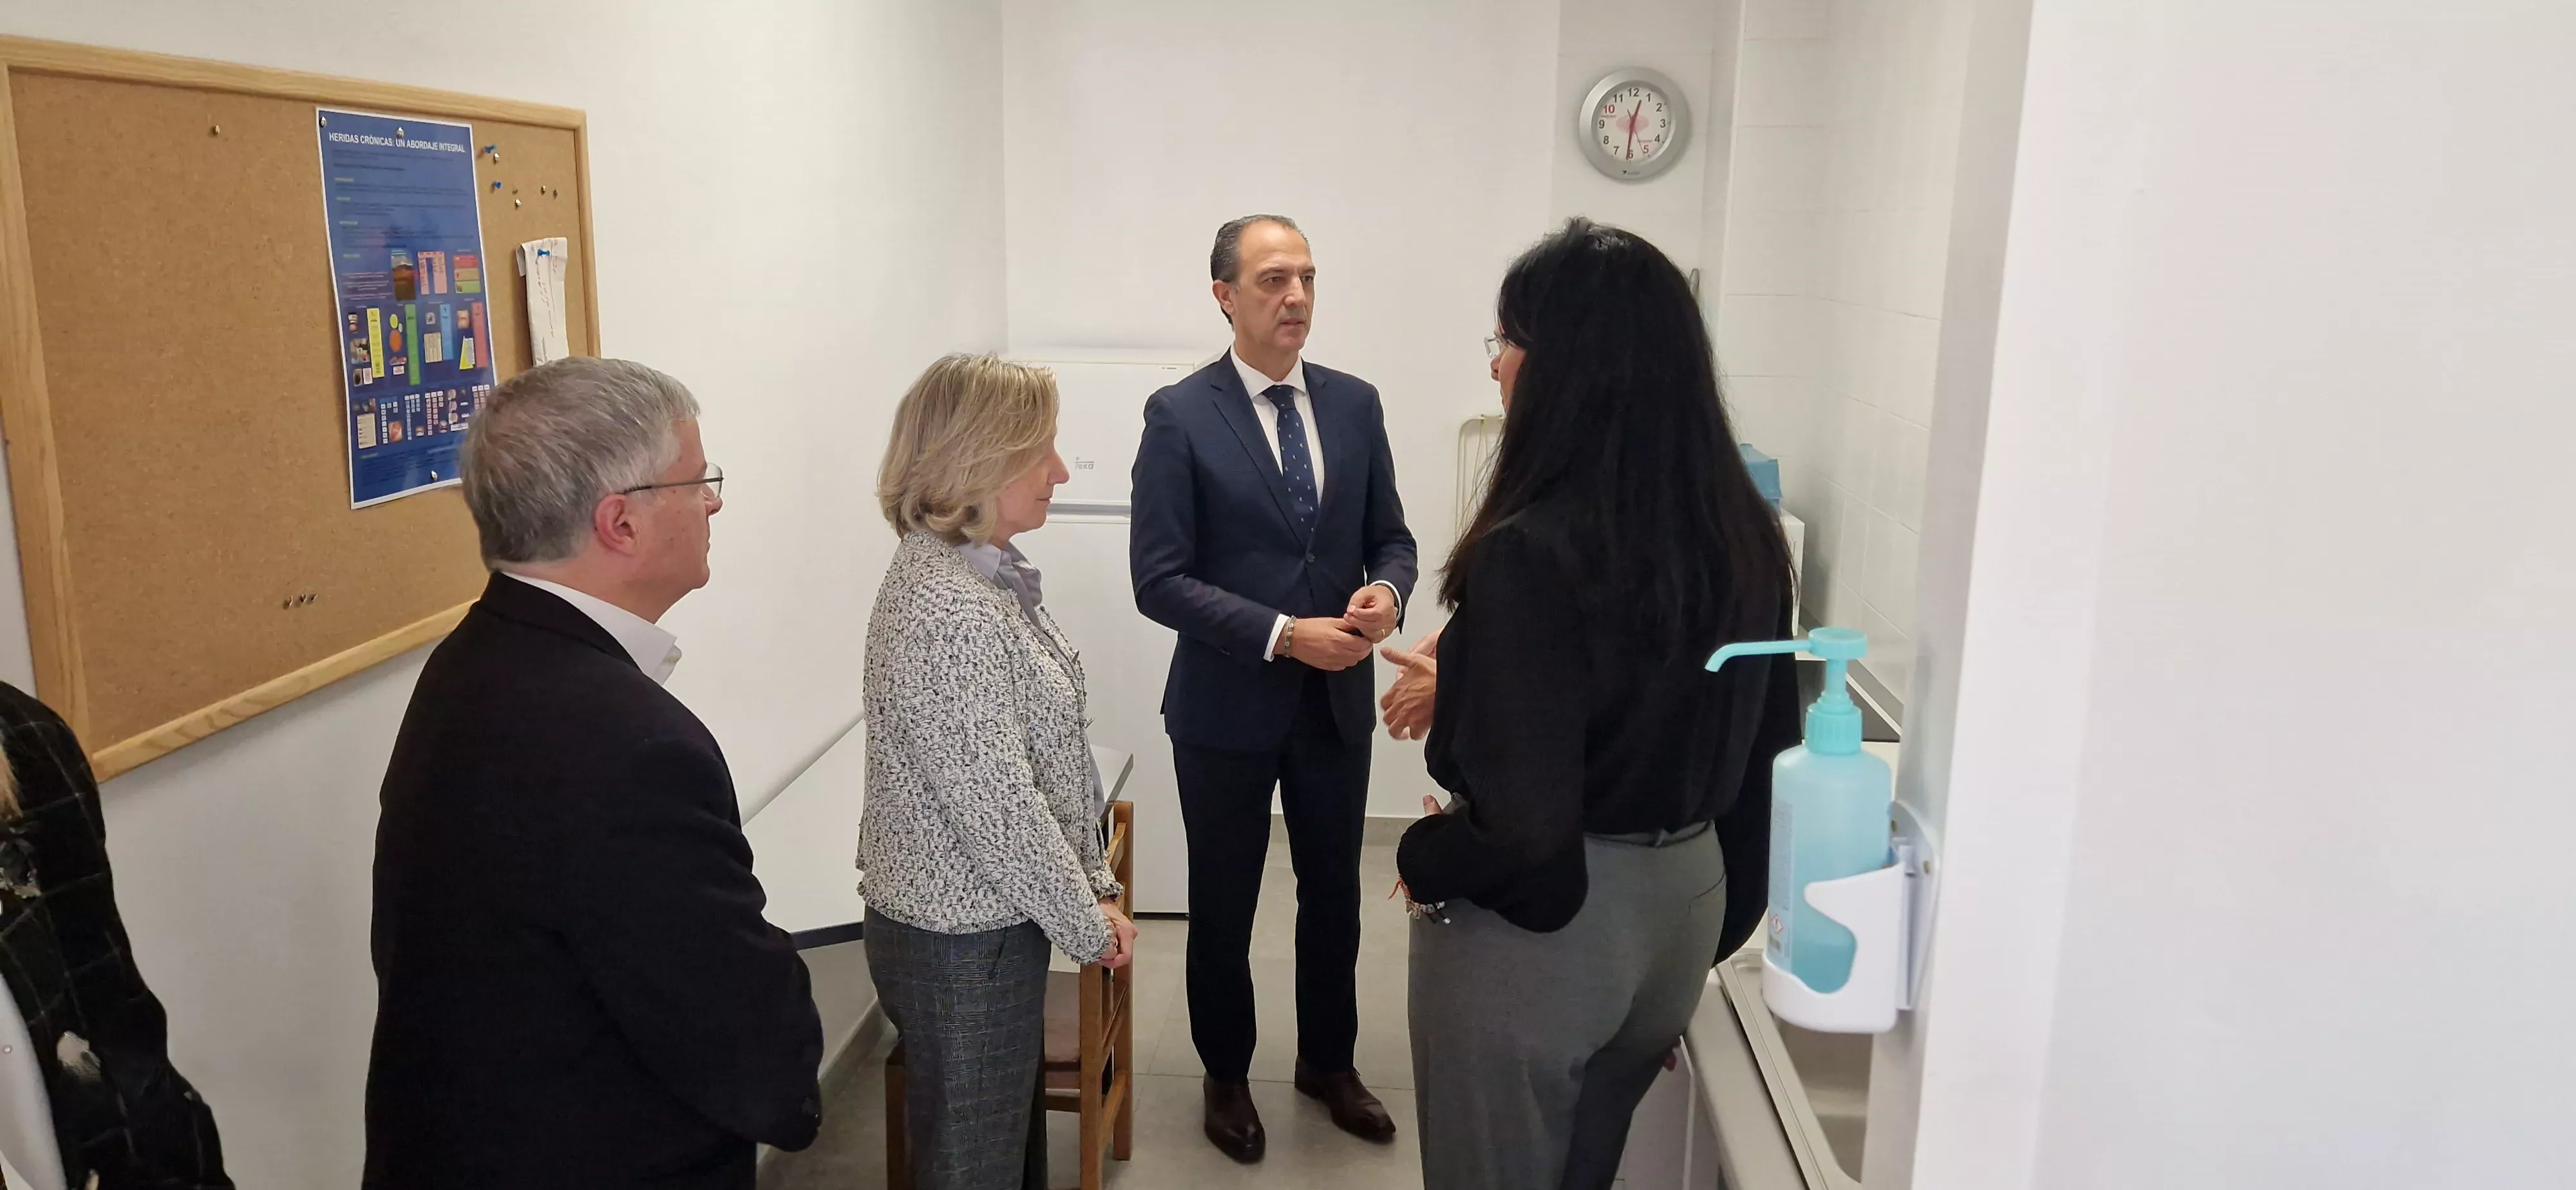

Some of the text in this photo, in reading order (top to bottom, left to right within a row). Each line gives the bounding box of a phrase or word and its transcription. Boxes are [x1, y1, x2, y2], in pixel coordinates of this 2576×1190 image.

[1627, 88, 1640, 97] 12
[1646, 93, 1651, 102] 1
[1613, 93, 1624, 103] 11
[1603, 104, 1615, 114] 10
[1656, 102, 1662, 112] 2
[1598, 119, 1605, 129] 9
[1660, 118, 1666, 128] 3
[329, 132, 466, 153] HERIDAS CRÓNICAS: UN ABORDAJE INTEGRAL
[1603, 135, 1609, 145] 8
[1654, 133, 1661, 143] 4
[1613, 146, 1620, 155] 7
[1627, 149, 1634, 159] 6
[1643, 144, 1649, 154] 5
